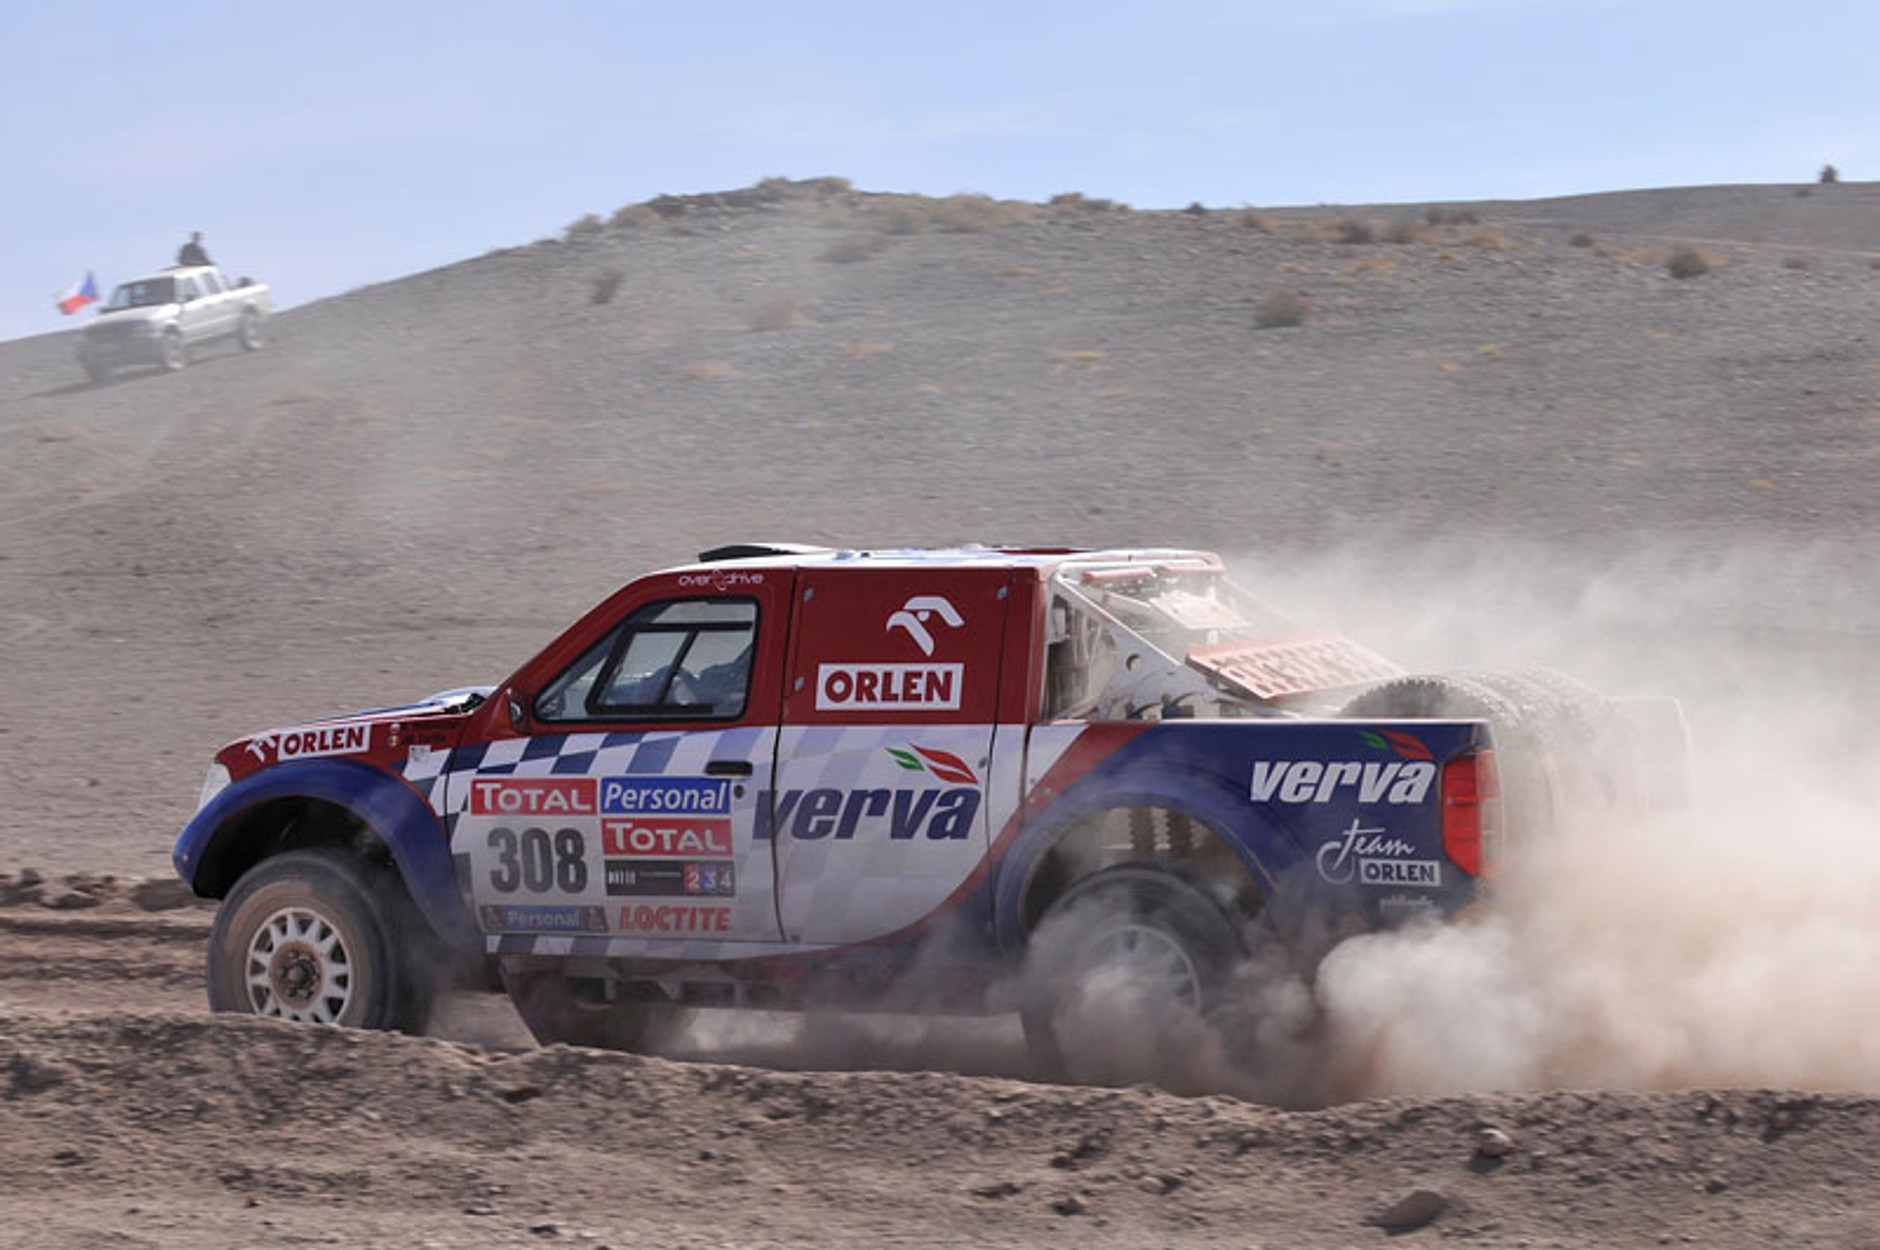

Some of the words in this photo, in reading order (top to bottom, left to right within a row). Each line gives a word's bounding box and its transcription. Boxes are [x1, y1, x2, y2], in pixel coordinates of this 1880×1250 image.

[825, 671, 953, 702] ORLEN
[284, 726, 363, 755] ORLEN
[605, 782, 727, 809] Personal
[1250, 761, 1436, 802] verva
[753, 788, 981, 840] verva
[487, 827, 587, 893] 308
[1365, 863, 1434, 882] ORLEN
[508, 907, 579, 928] Personal
[620, 906, 731, 930] LOCTITE
